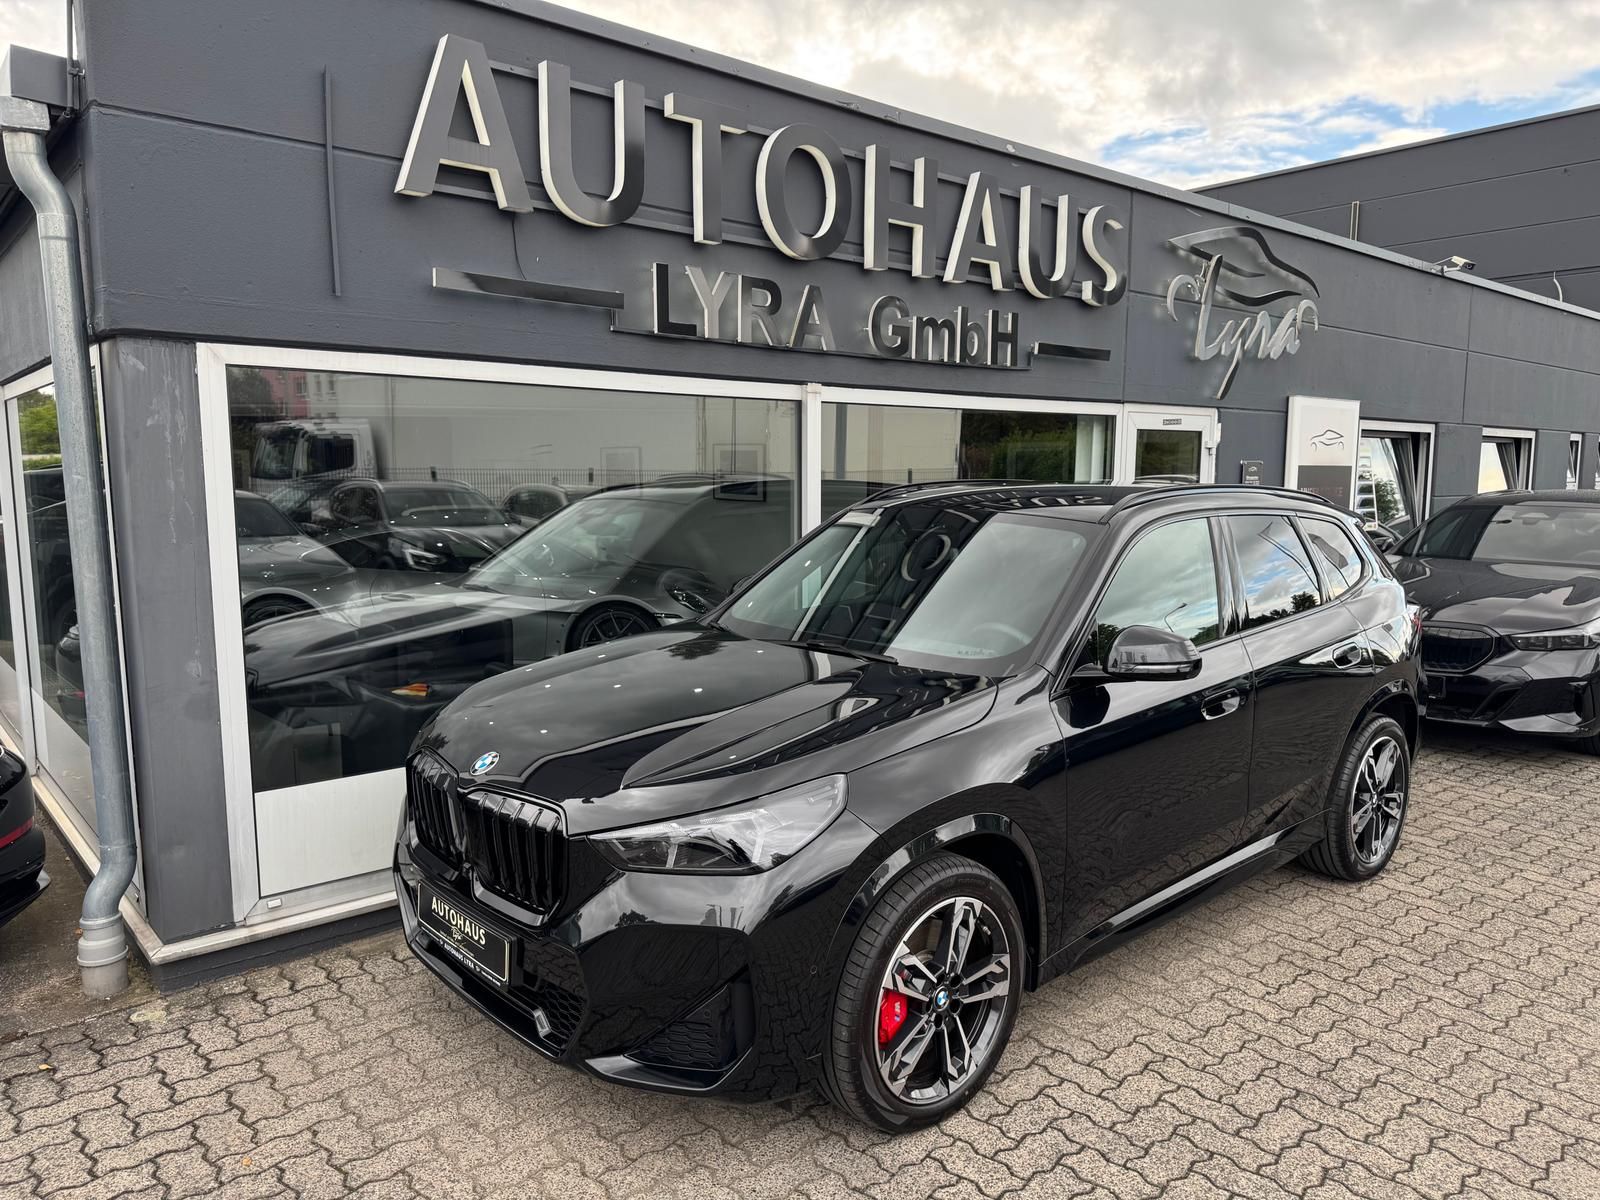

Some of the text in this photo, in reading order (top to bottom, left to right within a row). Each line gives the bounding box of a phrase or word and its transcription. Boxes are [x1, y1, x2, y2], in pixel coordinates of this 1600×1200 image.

[394, 33, 1127, 307] AUTOHAUS
[651, 262, 1019, 367] LYRA GmbH
[1194, 254, 1303, 400] Lyra
[431, 896, 486, 945] AUTOHAUS
